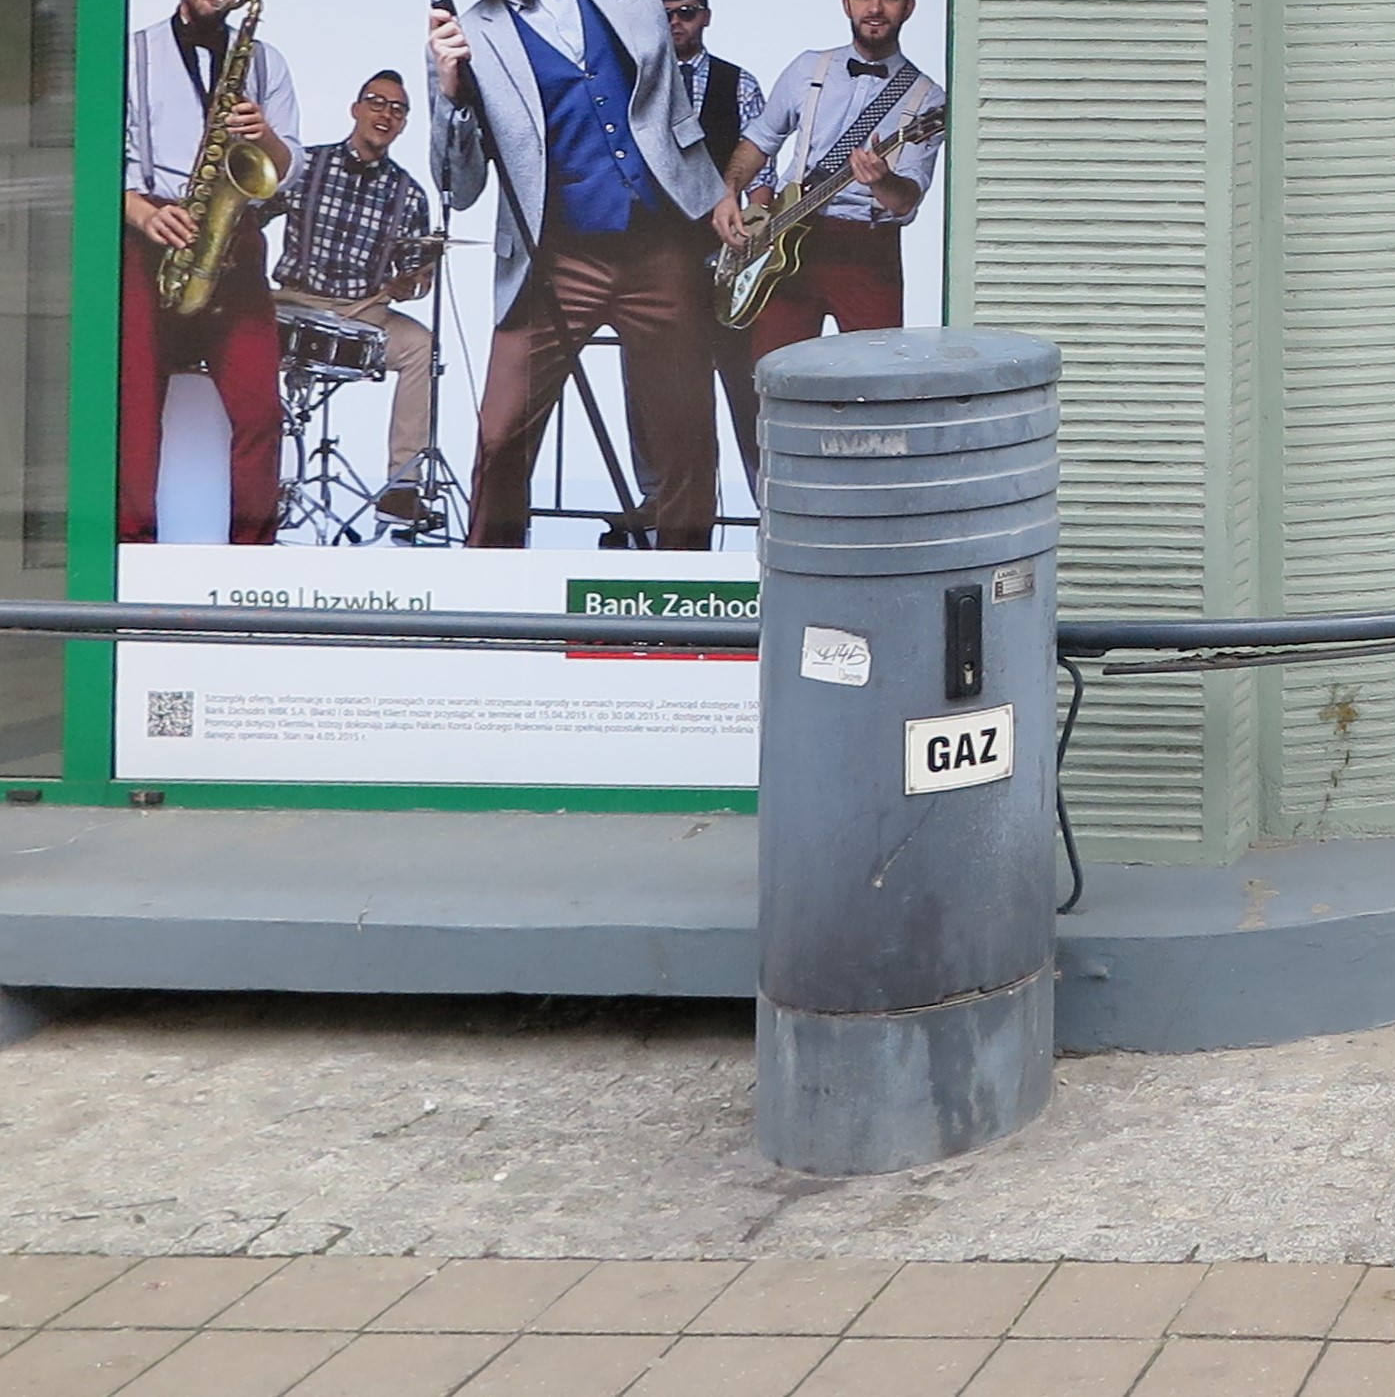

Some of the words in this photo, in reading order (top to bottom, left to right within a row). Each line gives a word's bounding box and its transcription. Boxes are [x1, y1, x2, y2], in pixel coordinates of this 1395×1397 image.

[230, 589, 291, 608] 9999
[585, 592, 654, 616] Bank
[927, 726, 998, 773] GAZ
